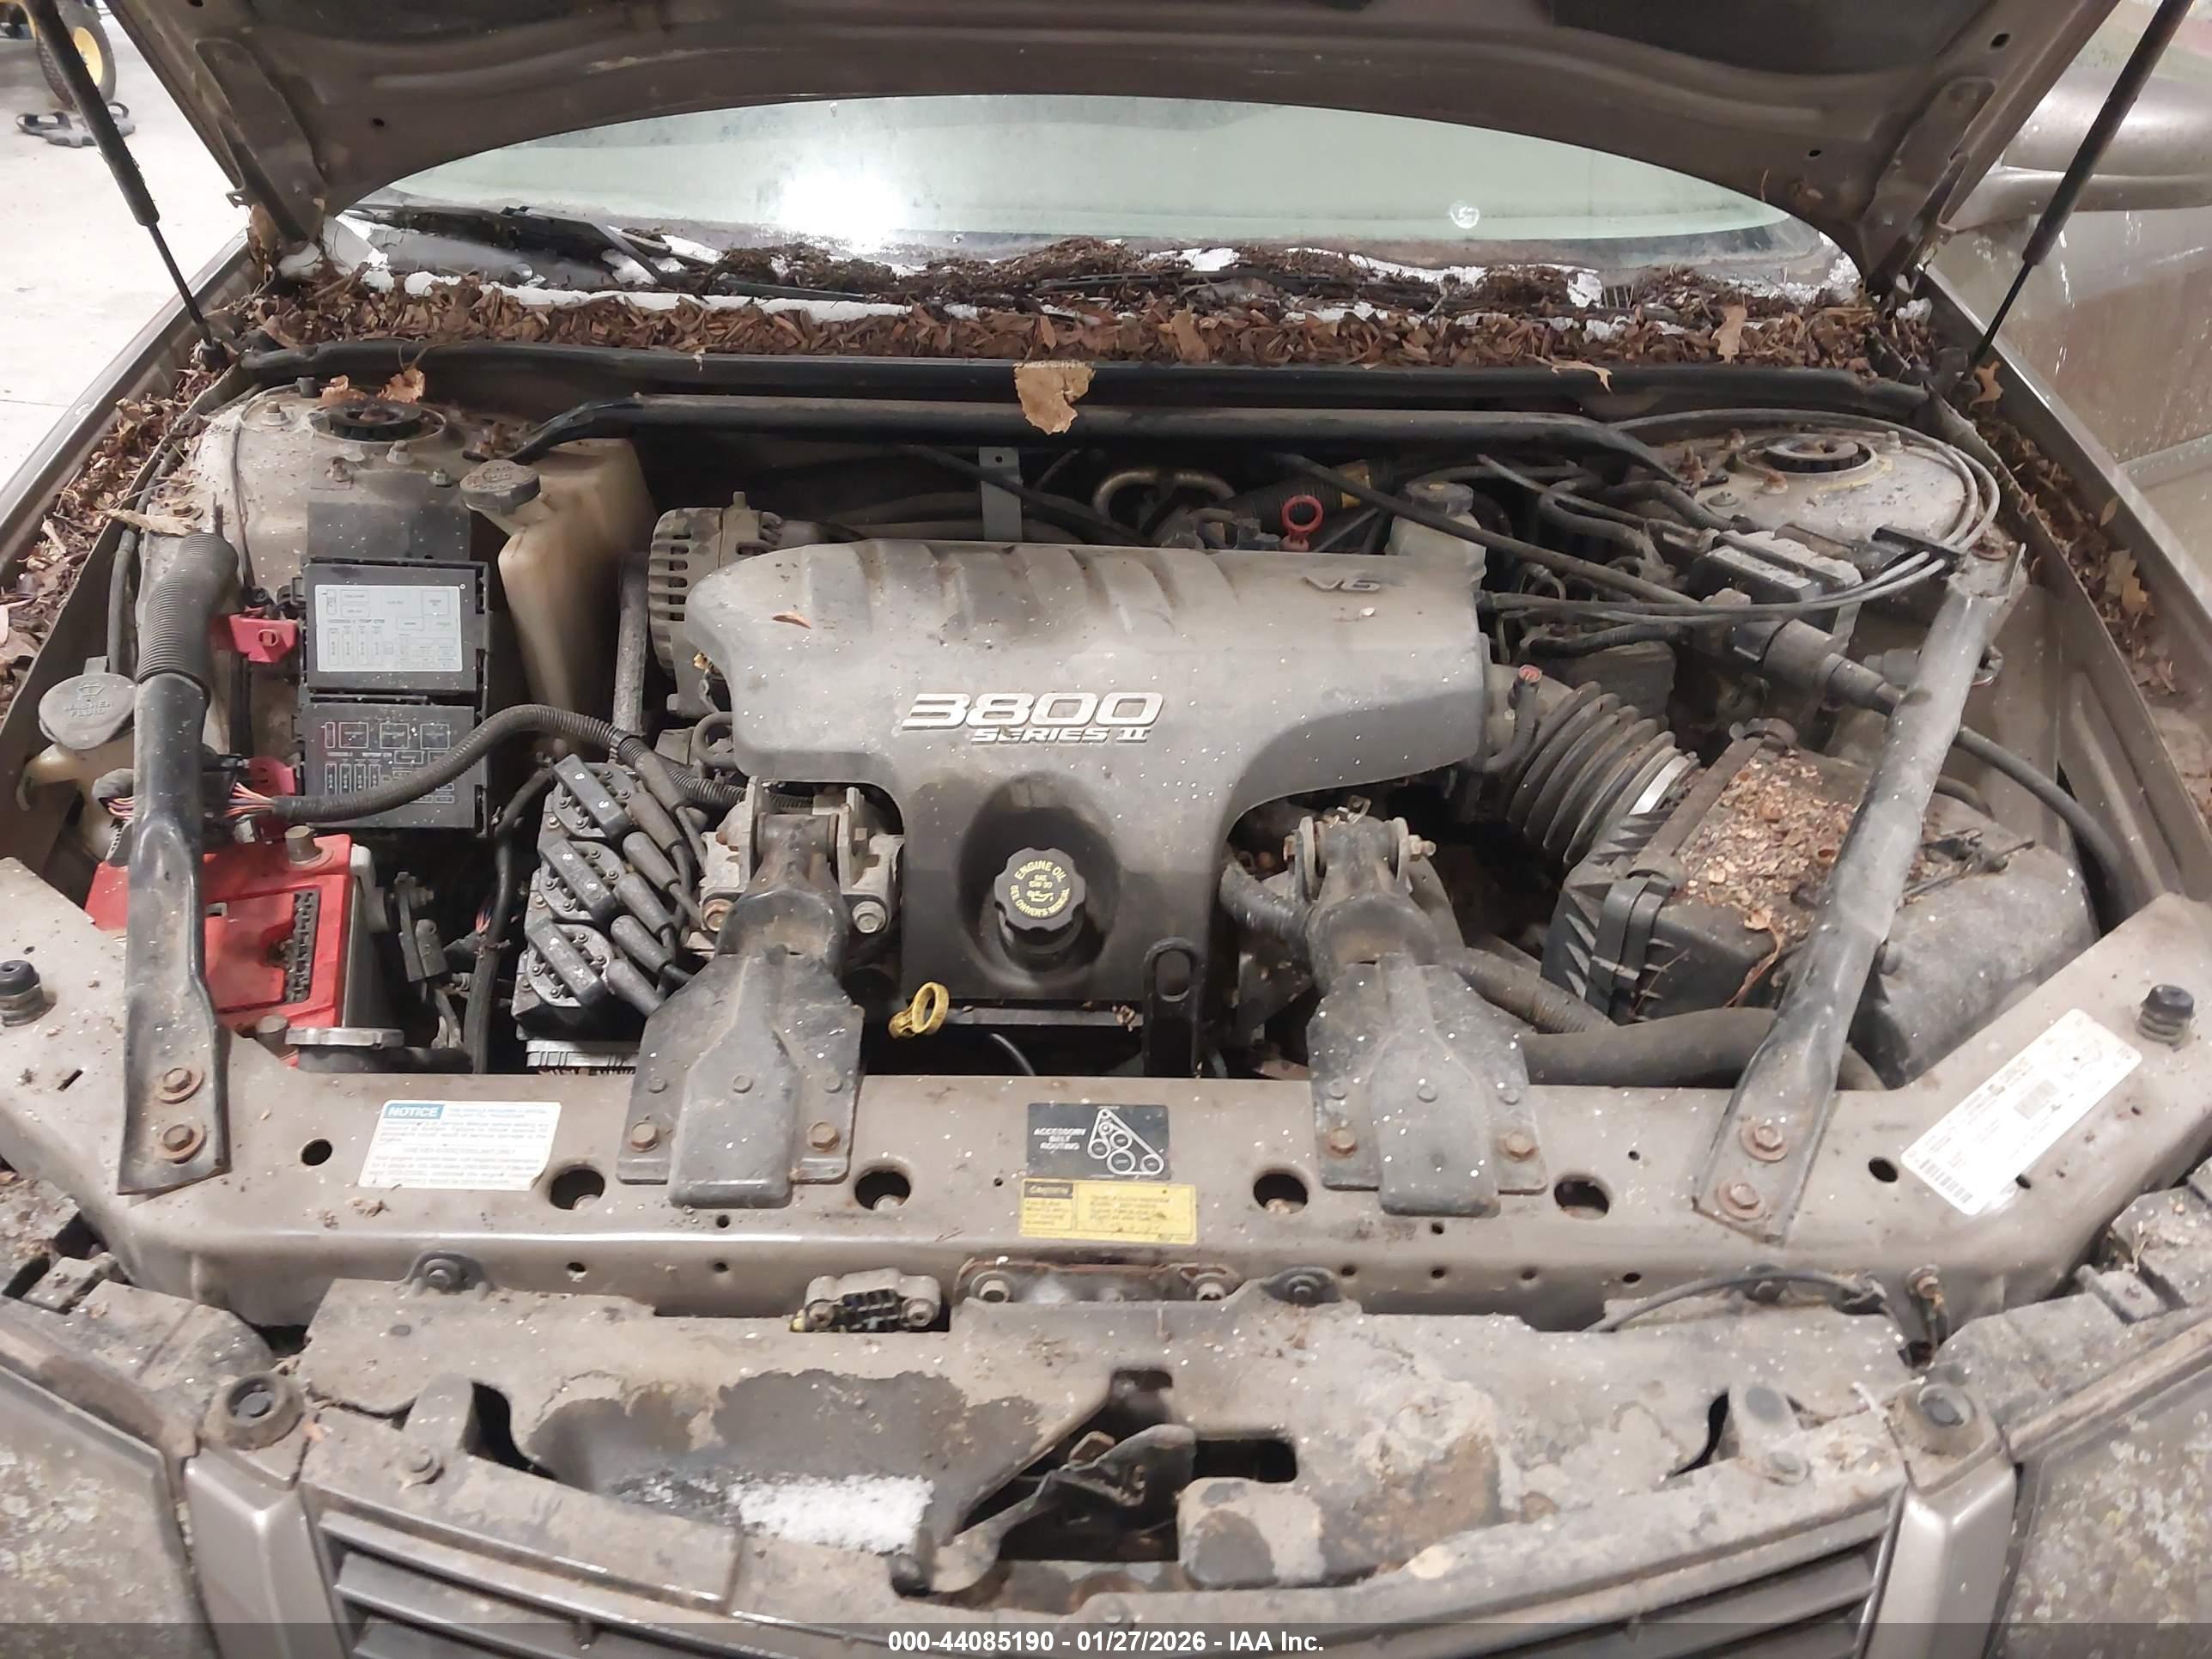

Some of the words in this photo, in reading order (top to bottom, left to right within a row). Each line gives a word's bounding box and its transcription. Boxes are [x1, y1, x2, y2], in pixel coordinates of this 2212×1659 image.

[1301, 573, 1381, 592] V6
[902, 692, 1164, 730] 3800
[971, 727, 1110, 744] SERIES
[1116, 728, 1152, 744] II
[1014, 860, 1053, 880] ENGINE
[1052, 866, 1066, 883] OIL
[387, 1106, 439, 1117] NOTICE
